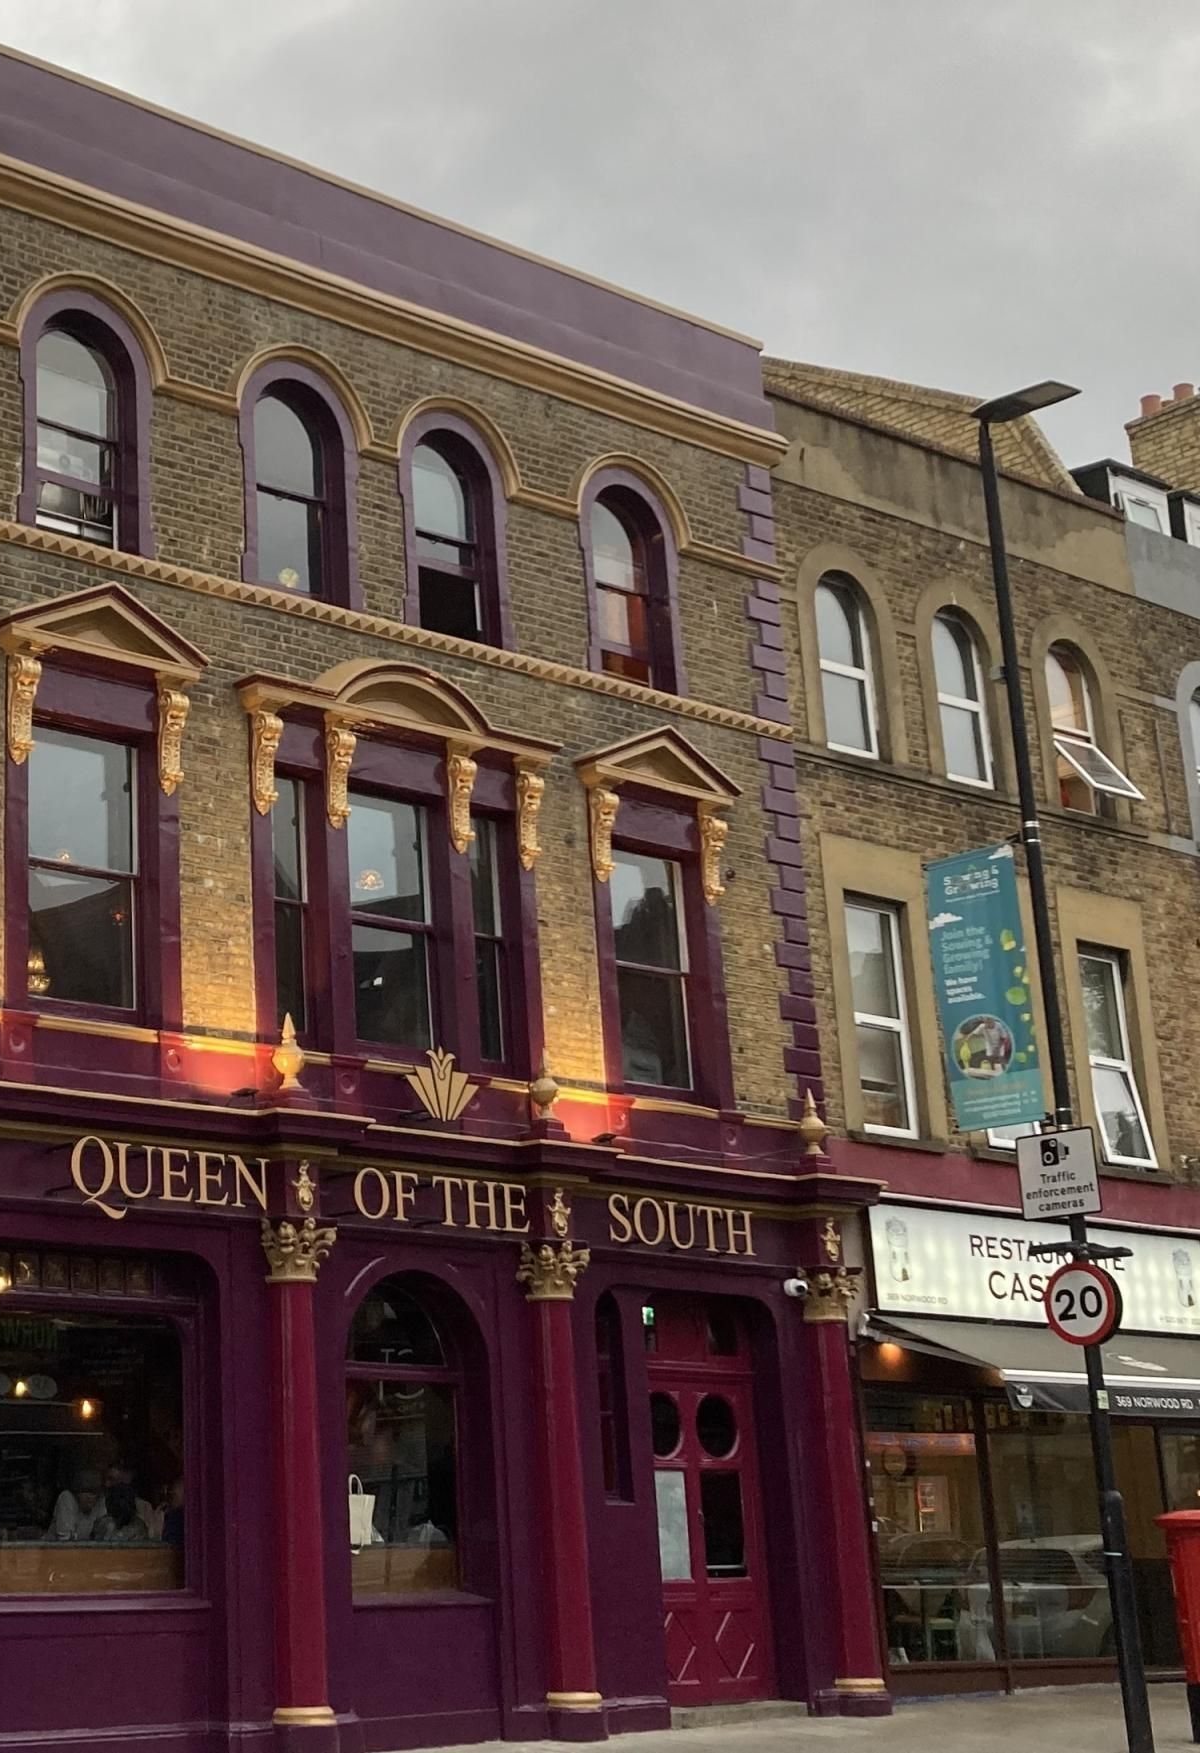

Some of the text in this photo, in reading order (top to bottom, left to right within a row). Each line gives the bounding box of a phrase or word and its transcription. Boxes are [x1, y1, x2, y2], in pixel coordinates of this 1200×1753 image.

[944, 877, 999, 896] Growing
[1040, 1170, 1076, 1183] Traffic
[71, 1135, 755, 1257] QUEEN OF THE SOUTH
[1025, 1181, 1095, 1201] enforcement
[1038, 1198, 1085, 1213] cameras
[1055, 1285, 1104, 1322] 20
[1115, 1395, 1133, 1408] 369
[1133, 1397, 1180, 1409] NORWOOD
[1180, 1399, 1194, 1410] RD
